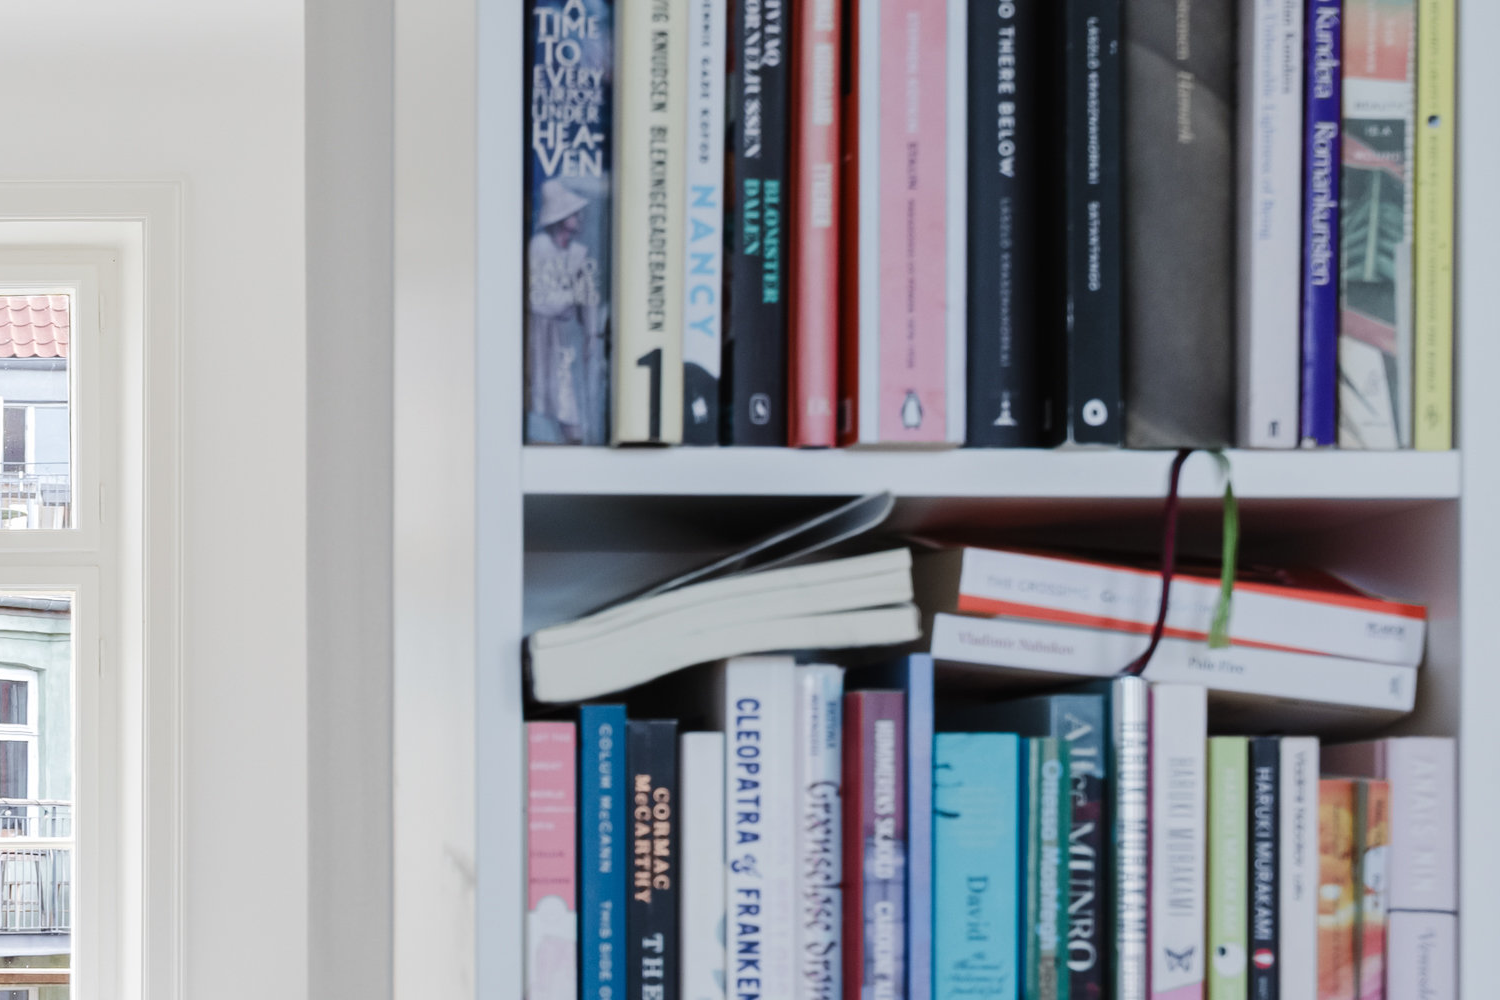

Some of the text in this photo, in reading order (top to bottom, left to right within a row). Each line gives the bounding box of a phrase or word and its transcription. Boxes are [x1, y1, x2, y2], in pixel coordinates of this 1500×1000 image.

[533, 7, 600, 41] TIME
[538, 36, 581, 67] TO
[1314, 6, 1340, 99] Kundera
[532, 104, 600, 123] UNDER
[533, 64, 603, 88] EVERY
[650, 30, 669, 113] KNUDSEN
[998, 24, 1015, 178] THERE BELOW
[533, 144, 602, 177] VEN
[1311, 121, 1338, 286] Romankunsten
[647, 126, 668, 332] BLEKINGEGADEBANDEN
[689, 185, 716, 338] NANCY
[743, 178, 761, 256] DALEN
[762, 179, 780, 303] BLOMSTER
[636, 347, 663, 442] 1
[598, 723, 613, 790] COLUM
[736, 697, 761, 846] CLEOPATRA
[633, 773, 651, 904] McCARTHY
[652, 786, 671, 891] CORMAC
[1165, 757, 1195, 918] HARUKI MURAKAMI
[1254, 766, 1273, 941] HARUKI MURAKAMI
[598, 900, 612, 939] THIS
[966, 875, 989, 942] David
[1066, 822, 1097, 972] MUNRO
[598, 943, 612, 981] SIDE
